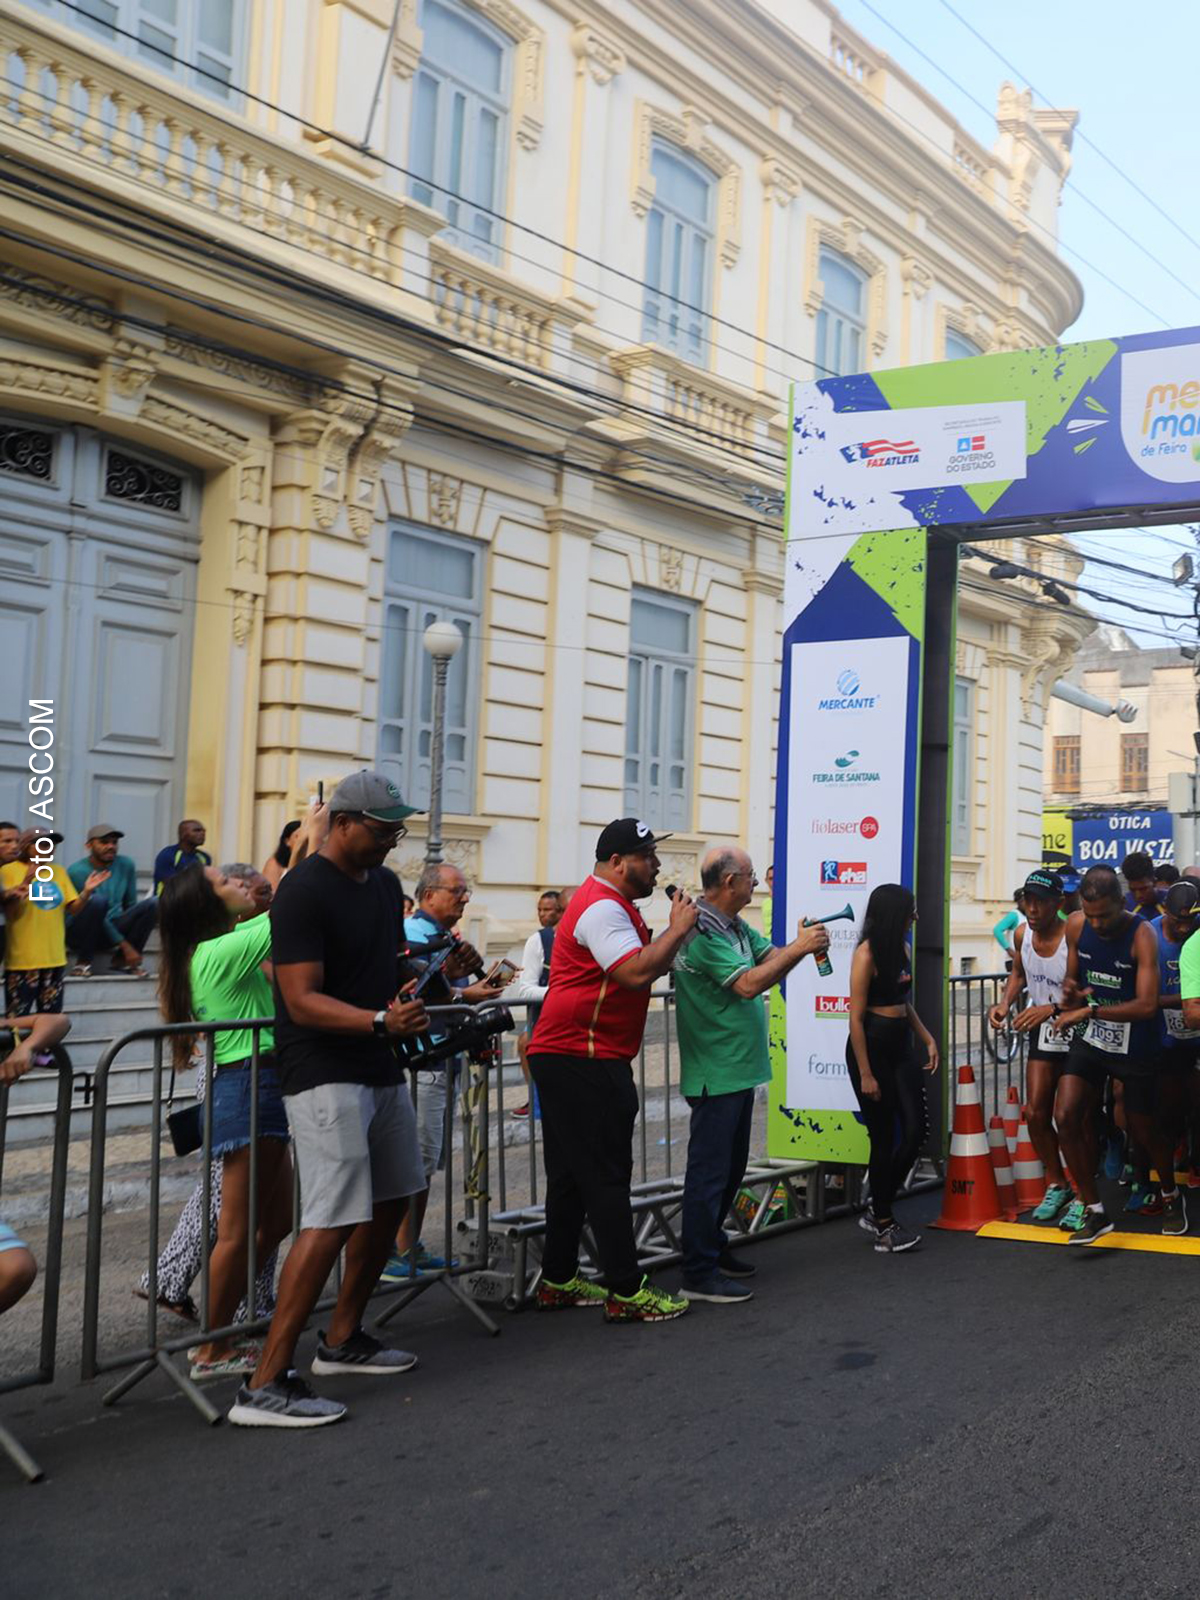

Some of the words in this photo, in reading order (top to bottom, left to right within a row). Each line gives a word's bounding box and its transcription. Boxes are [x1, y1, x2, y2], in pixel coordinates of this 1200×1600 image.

[1141, 443, 1155, 457] de
[1158, 441, 1187, 455] Feira
[866, 454, 919, 468] FAZATLETA
[949, 451, 994, 464] GOVERNO
[946, 465, 960, 473] DO
[961, 460, 996, 472] ESTADO
[818, 697, 875, 711] MERCANTE
[812, 773, 834, 783] FEIRA
[835, 773, 844, 782] DE
[846, 772, 880, 782] SANTANA
[1108, 813, 1152, 830] ÓTICA
[1079, 839, 1118, 861] BOA
[1091, 1024, 1124, 1044] 1093
[951, 1180, 976, 1196] SMT
